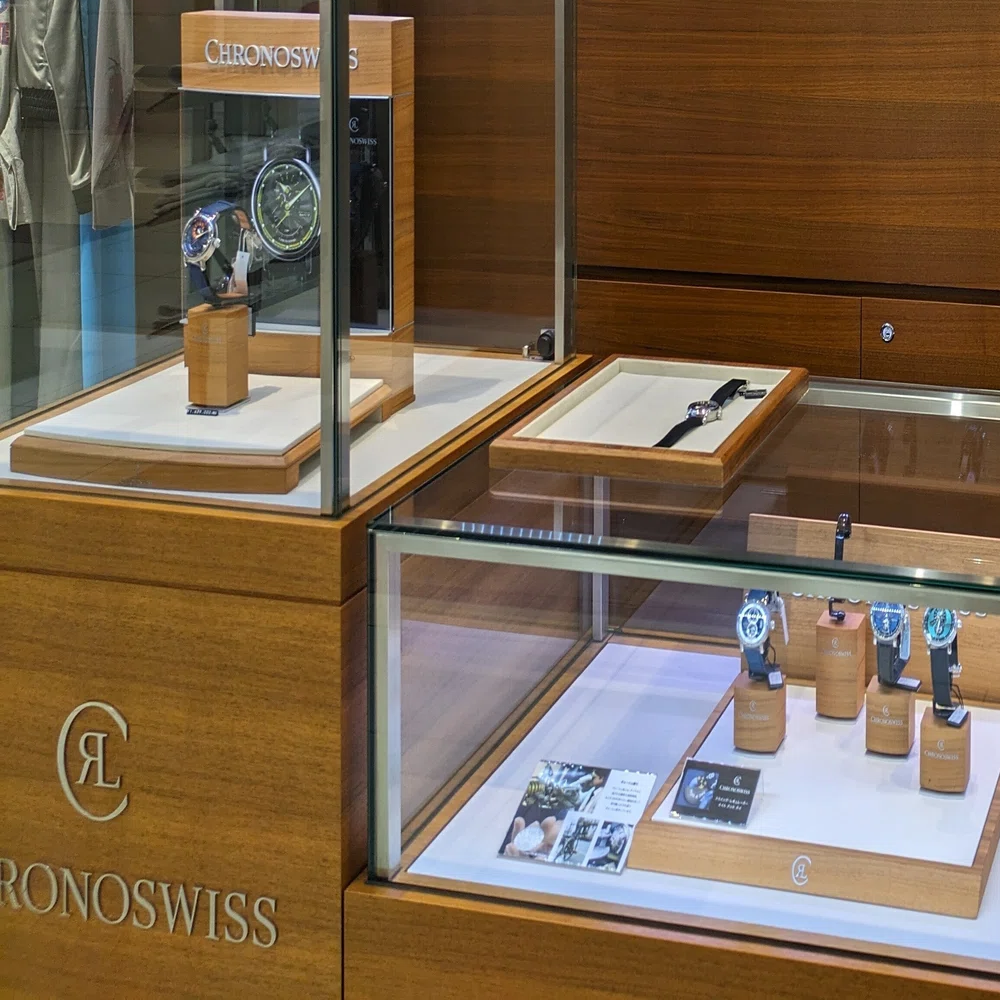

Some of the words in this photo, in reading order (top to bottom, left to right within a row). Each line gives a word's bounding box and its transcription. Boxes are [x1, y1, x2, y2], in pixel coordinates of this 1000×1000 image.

[204, 38, 359, 71] CHRONOSWS
[350, 137, 377, 145] NOSWISS
[0, 858, 278, 949] RONOSWISS
